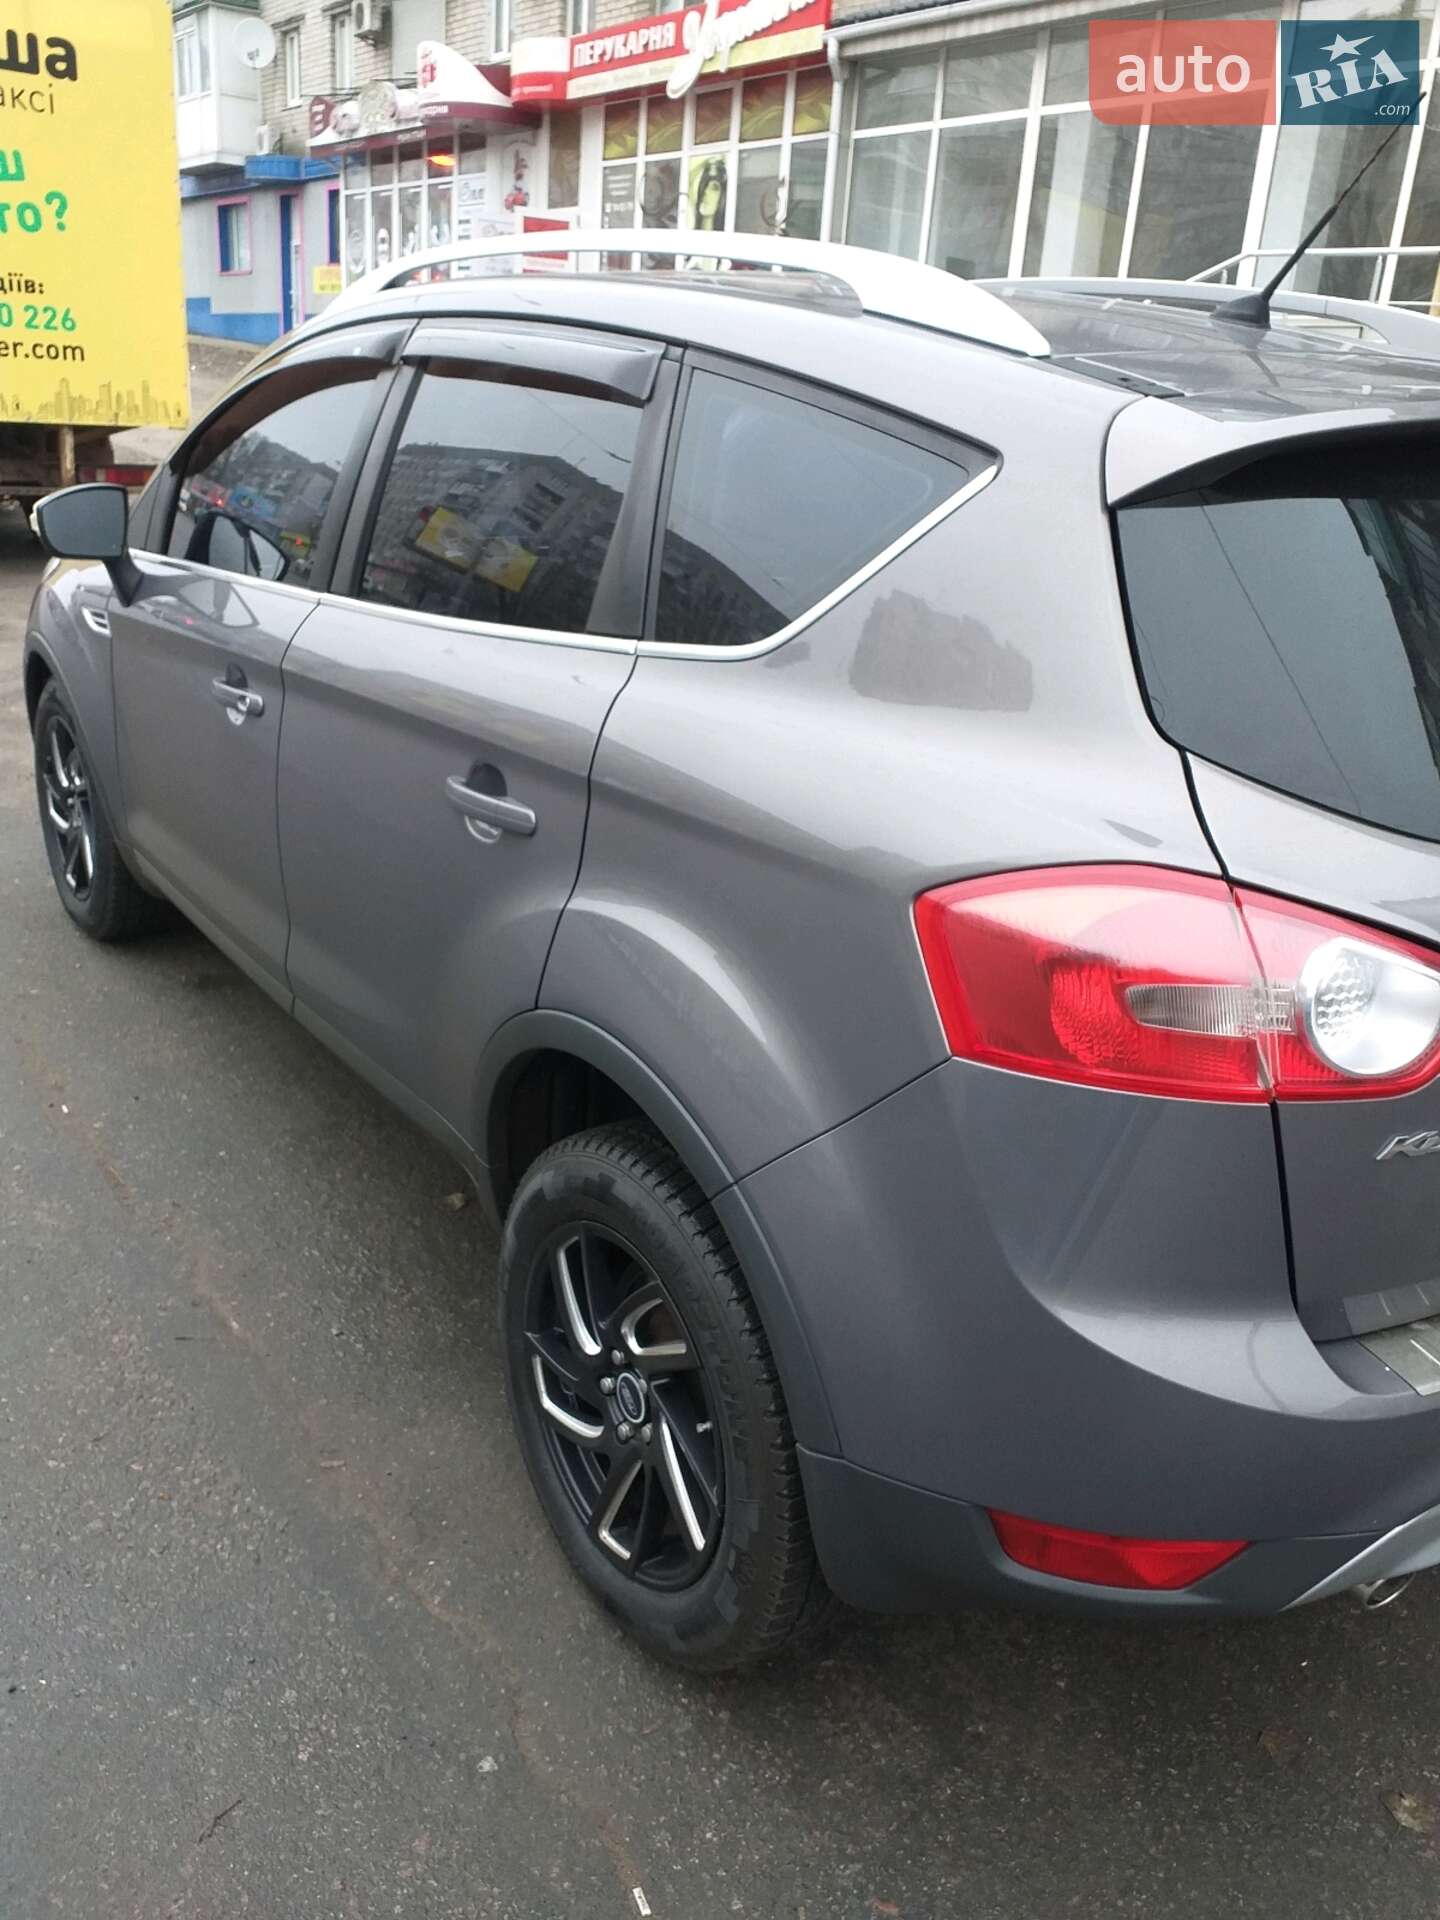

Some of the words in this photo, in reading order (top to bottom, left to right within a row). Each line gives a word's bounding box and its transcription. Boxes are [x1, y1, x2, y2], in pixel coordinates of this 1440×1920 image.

[573, 22, 677, 68] ПЕРУКАРНЯ
[24, 304, 77, 332] 226
[0, 340, 85, 362] er.com
